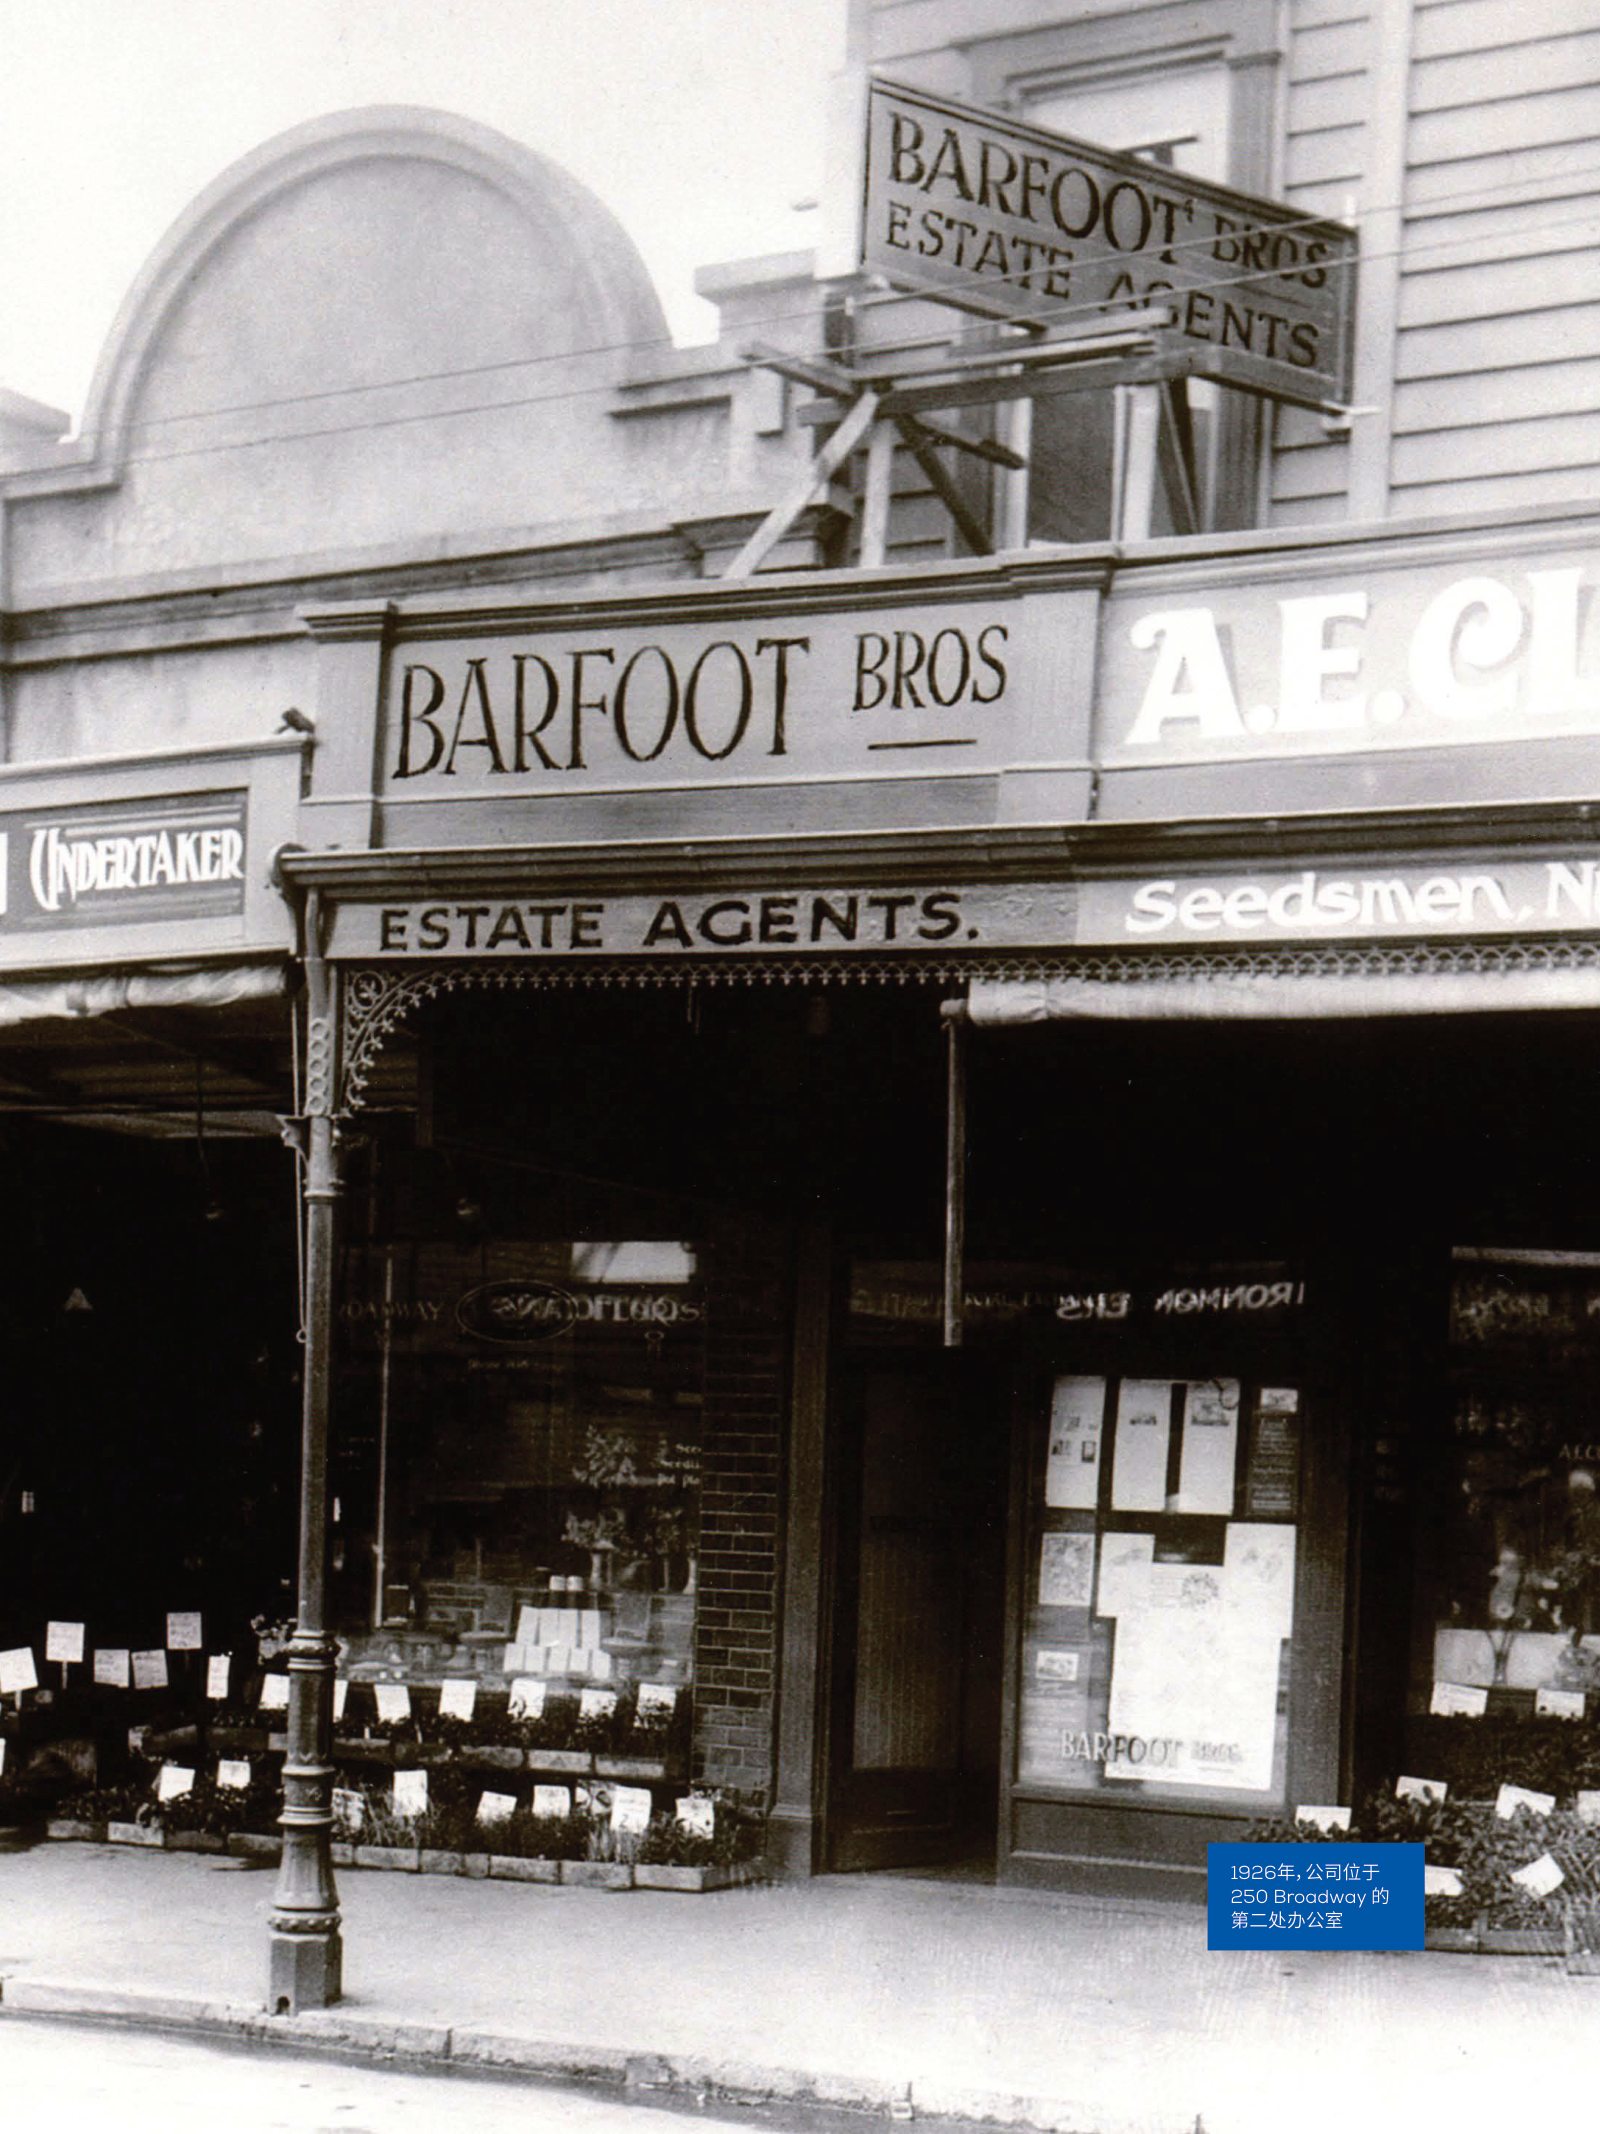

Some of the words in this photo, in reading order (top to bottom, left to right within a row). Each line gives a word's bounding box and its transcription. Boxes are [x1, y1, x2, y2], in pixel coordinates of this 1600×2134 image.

[886, 111, 1194, 264] BARFOOT
[1211, 213, 1327, 289] BROS
[886, 201, 1075, 300] ESTATE
[393, 637, 810, 780] BARFOOT
[852, 625, 1009, 713] BROS
[30, 827, 245, 911] UNDERTAKER
[1125, 871, 1534, 934] Seedsmen,
[1544, 862, 1600, 920] N
[379, 902, 604, 952] ESTATE
[643, 892, 979, 949] AGENTS.
[1061, 1729, 1183, 1768] BARFOOT
